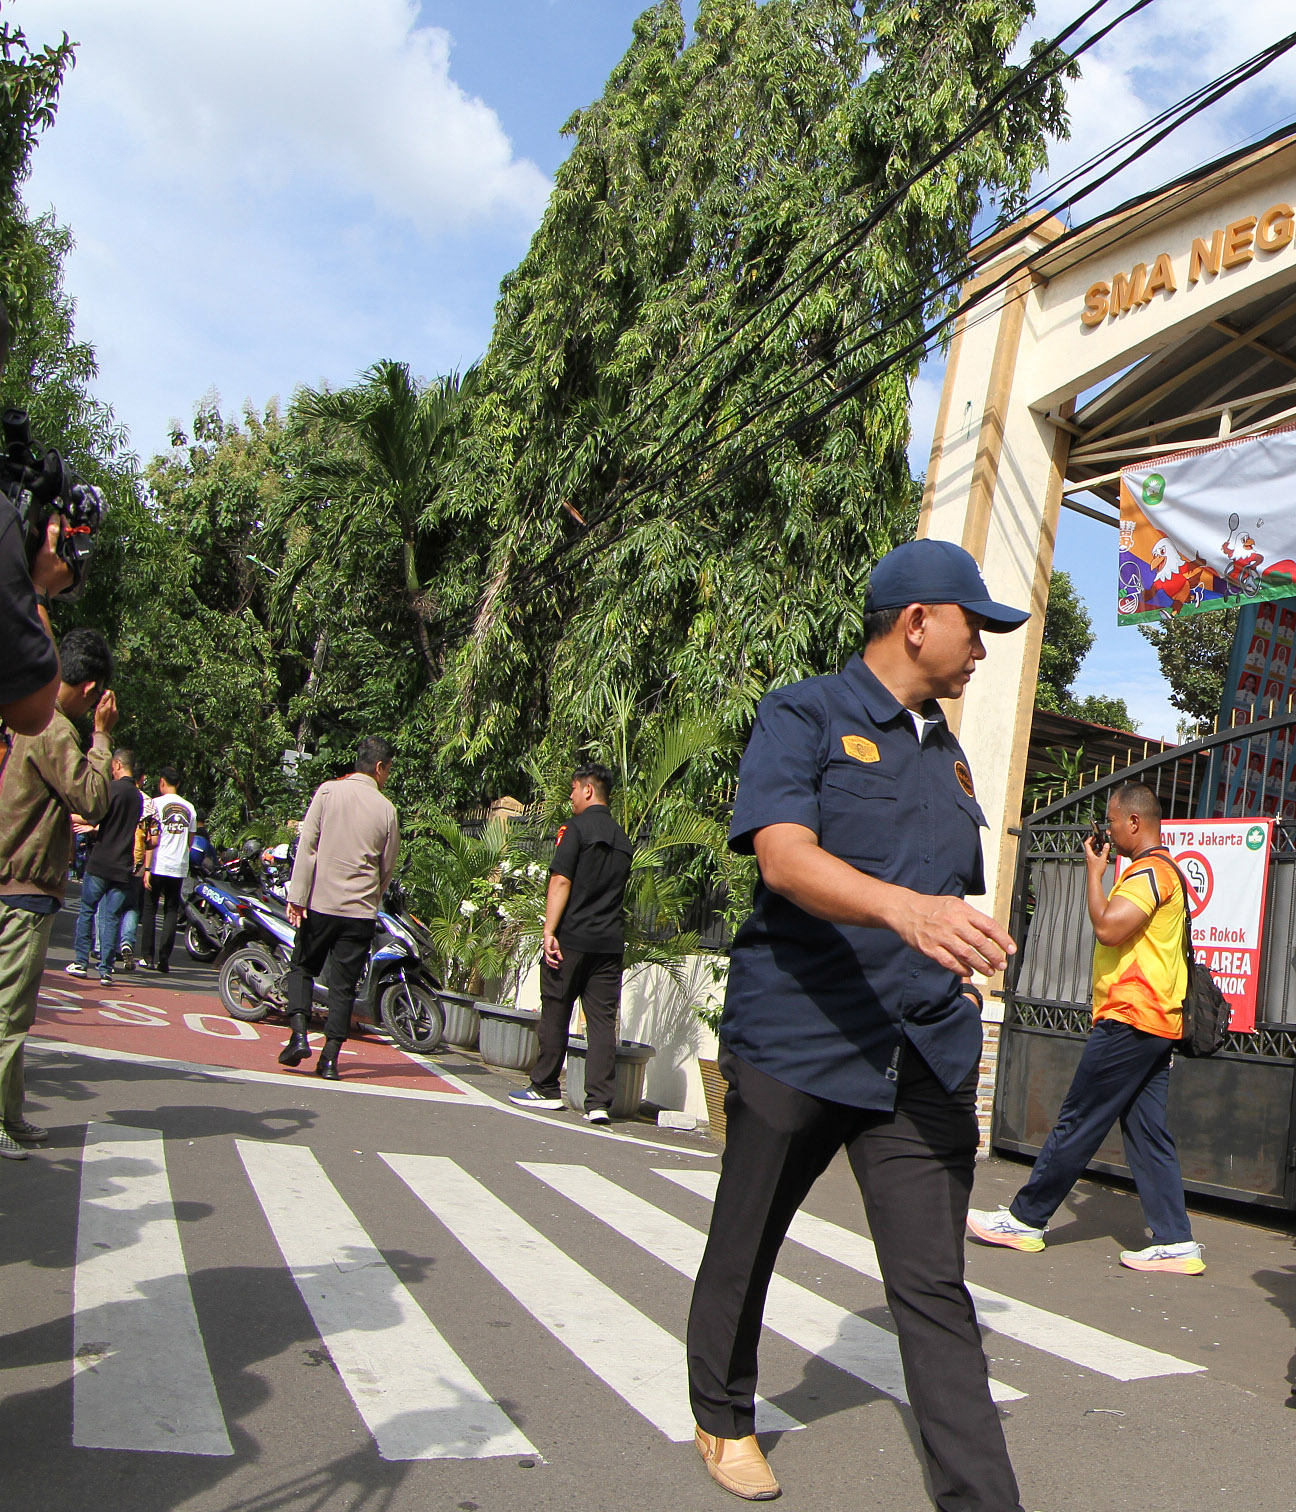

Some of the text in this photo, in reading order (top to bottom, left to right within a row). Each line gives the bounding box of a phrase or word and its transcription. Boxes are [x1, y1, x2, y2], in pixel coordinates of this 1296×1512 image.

[1080, 253, 1178, 327] SMA
[1160, 831, 1243, 846] AN 72 Jakarta
[1210, 927, 1246, 943] Rokok
[1210, 951, 1252, 975] AREA
[1212, 976, 1246, 995] OKOK
